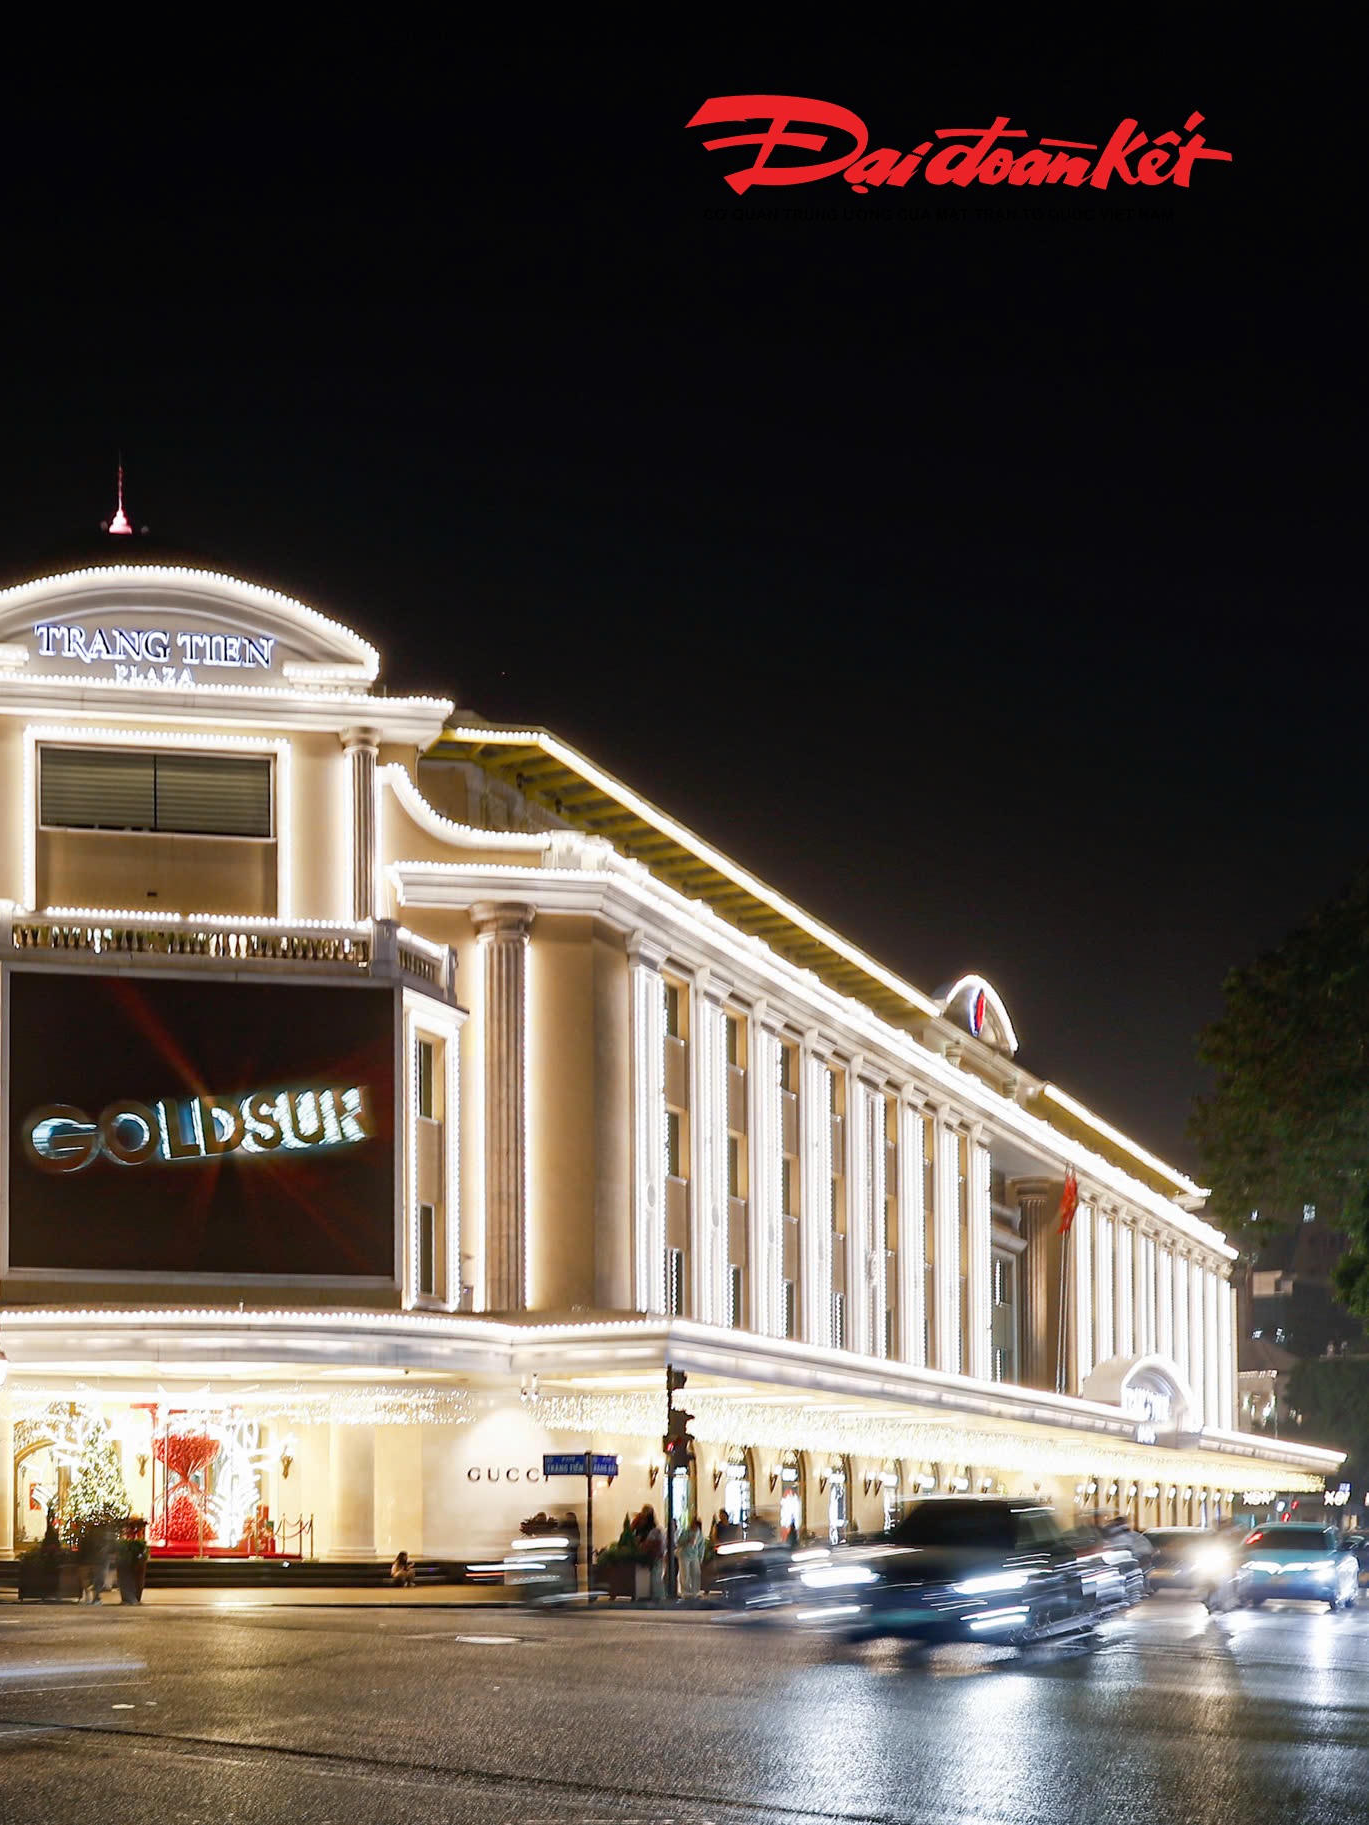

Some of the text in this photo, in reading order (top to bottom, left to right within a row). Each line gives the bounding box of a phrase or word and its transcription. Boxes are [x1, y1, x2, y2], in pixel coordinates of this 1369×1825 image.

[34, 624, 277, 669] TRANG TIEN
[114, 663, 194, 688] PLAZA
